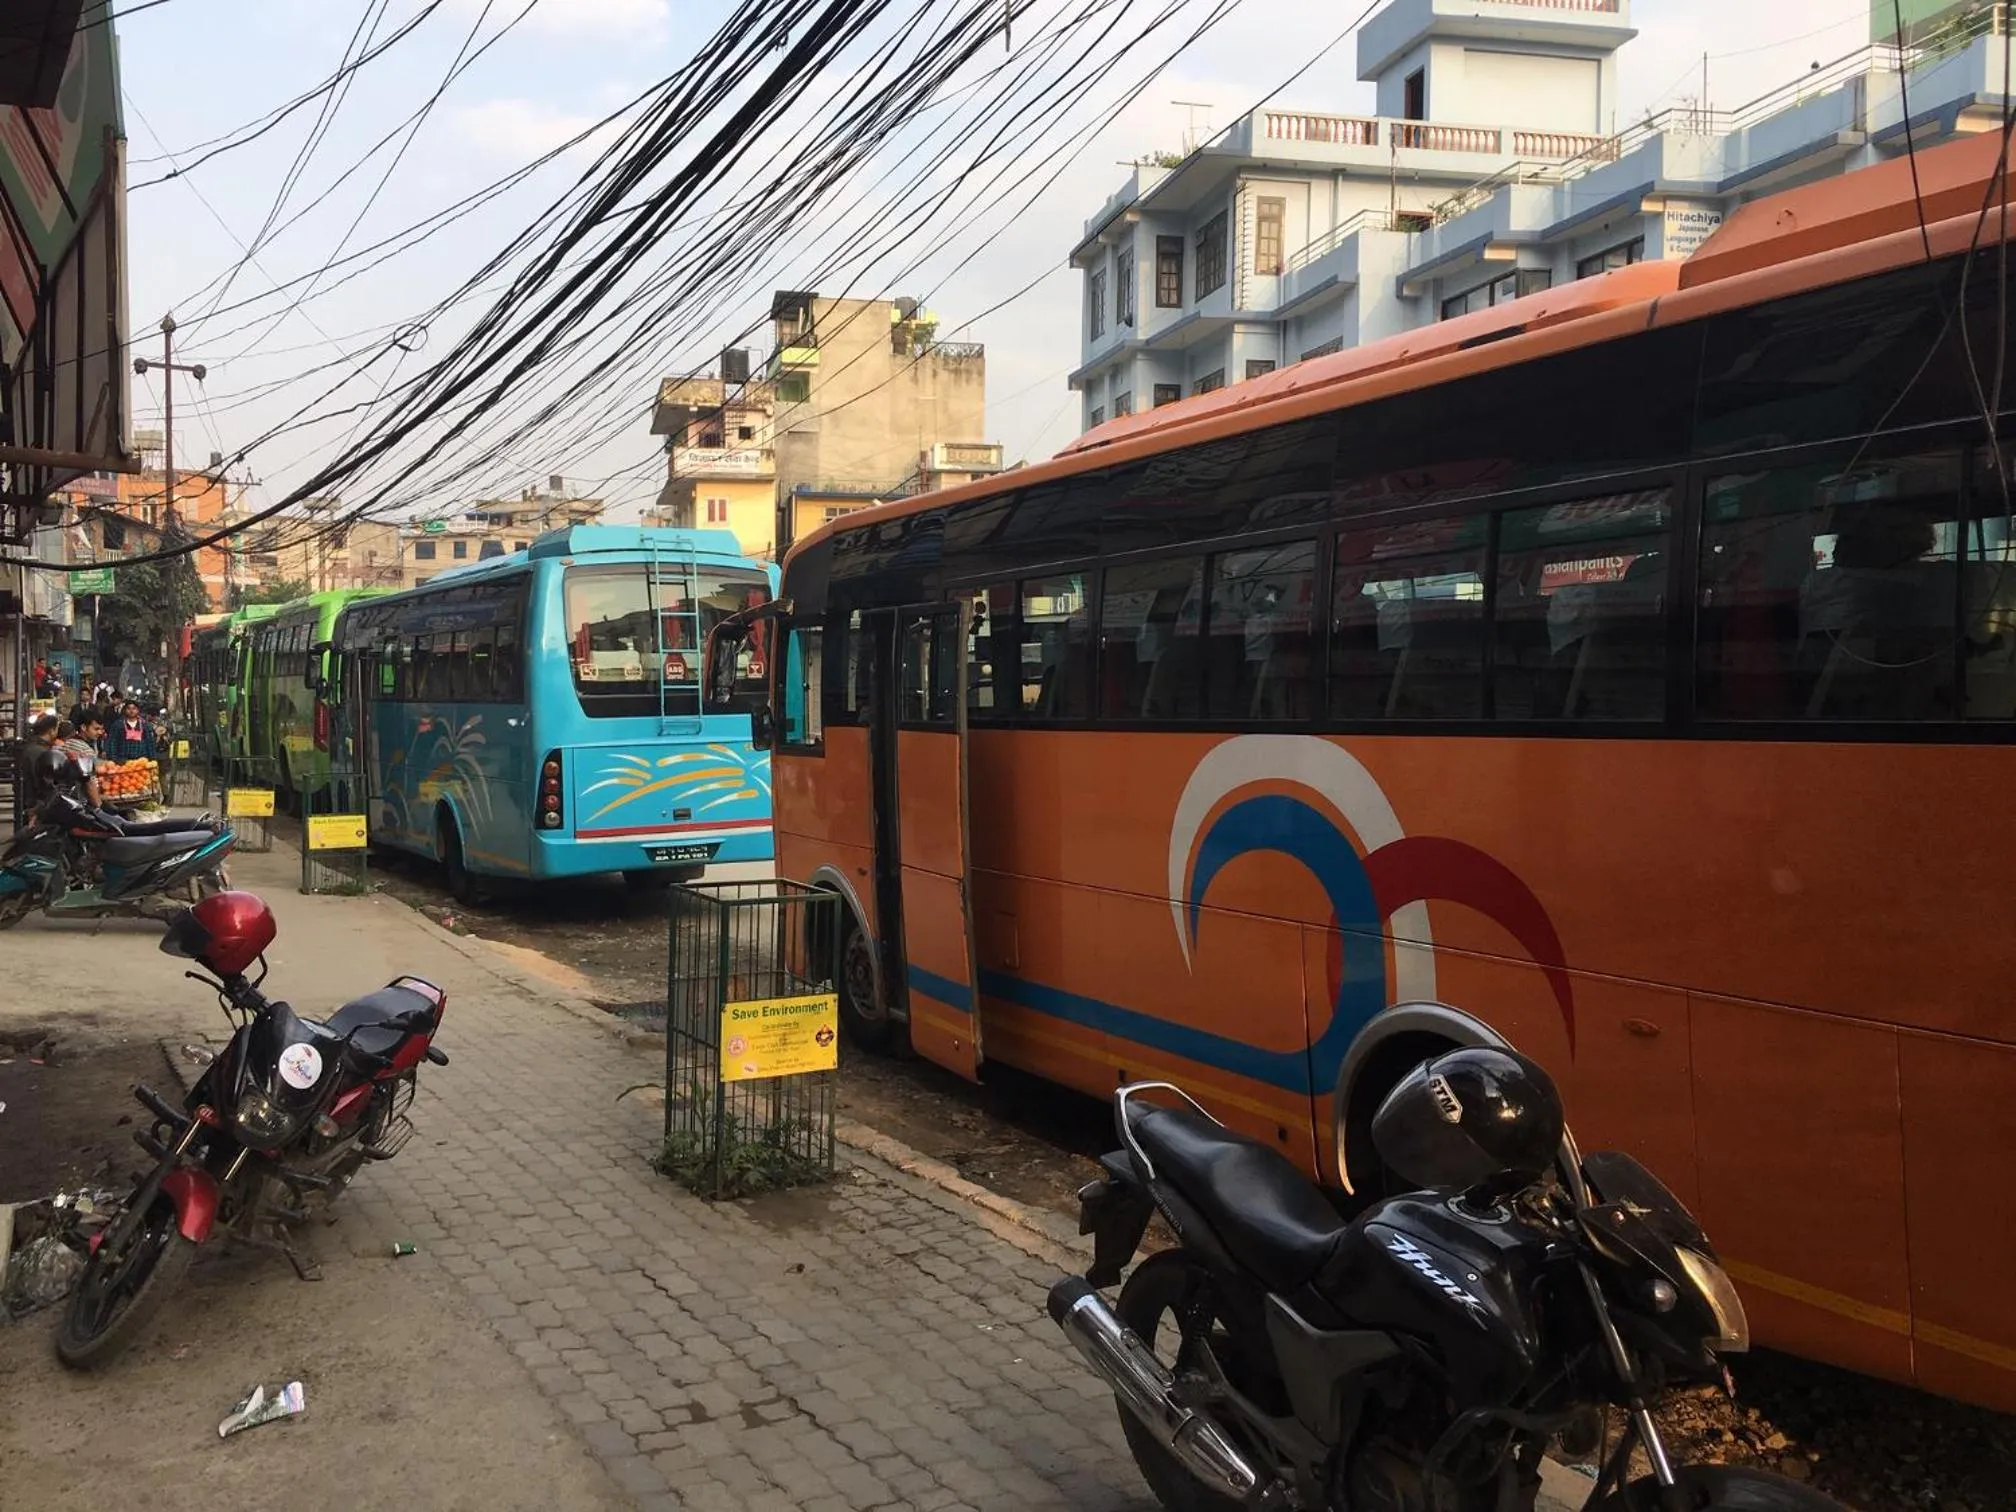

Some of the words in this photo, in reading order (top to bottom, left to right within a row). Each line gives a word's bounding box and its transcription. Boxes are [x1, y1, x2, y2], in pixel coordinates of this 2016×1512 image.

[1667, 211, 1720, 226] Hitachiya
[731, 1008, 759, 1021] Save
[761, 1001, 829, 1017] Environment
[1428, 1078, 1459, 1114] STM
[1386, 1232, 1489, 1331] Hunk
